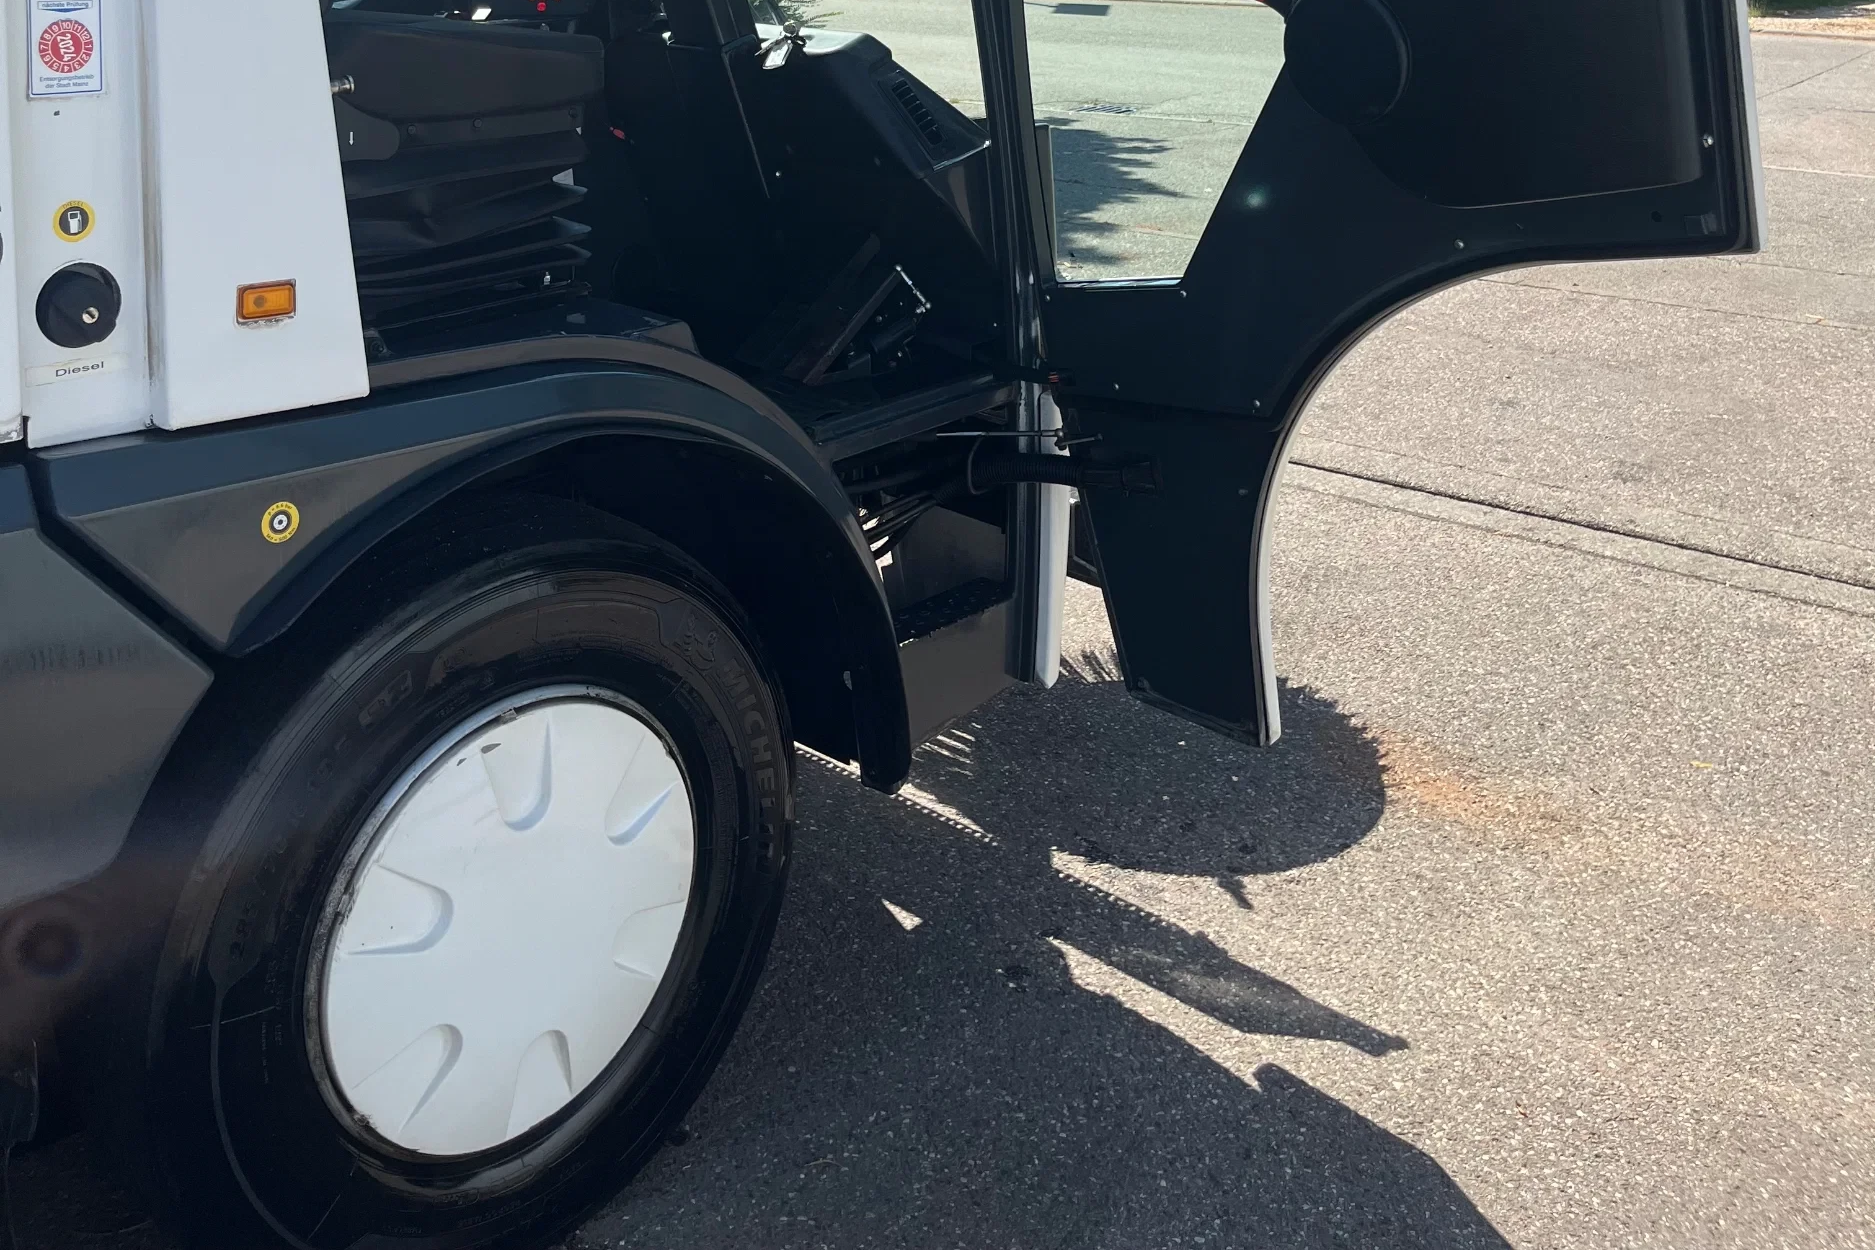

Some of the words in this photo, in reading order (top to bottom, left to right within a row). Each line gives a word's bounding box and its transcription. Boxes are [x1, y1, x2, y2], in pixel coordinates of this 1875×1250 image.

[61, 21, 71, 29] 10
[73, 23, 82, 33] 11
[81, 31, 91, 41] 12
[56, 33, 77, 61] 2024
[63, 200, 84, 209] DIESEL
[55, 361, 104, 377] Diesel
